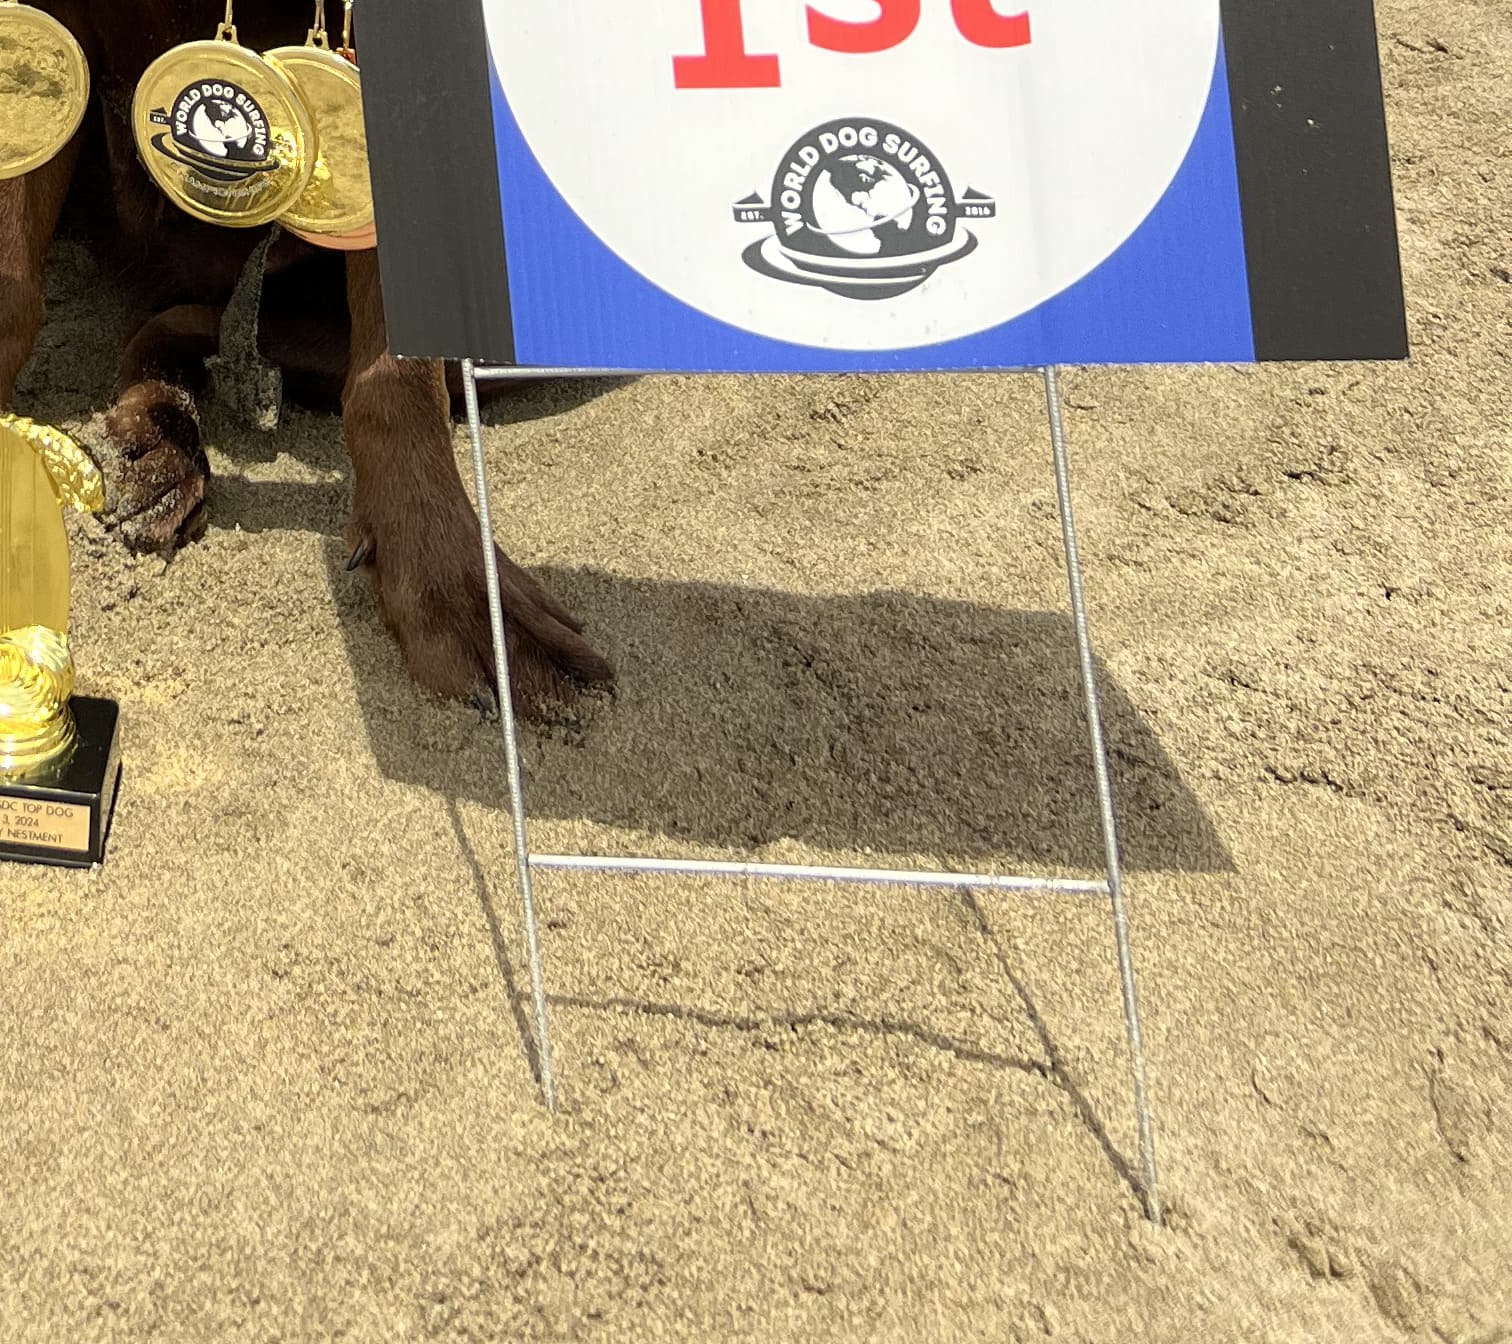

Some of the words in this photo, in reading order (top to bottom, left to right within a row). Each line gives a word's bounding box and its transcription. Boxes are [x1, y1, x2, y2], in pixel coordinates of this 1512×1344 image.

[175, 88, 201, 136] WORLD
[201, 83, 235, 99] DOG
[235, 93, 267, 156] SURFING
[780, 145, 820, 237] WORLD
[818, 125, 878, 154] DOG
[882, 133, 947, 236] SURFING
[22, 802, 42, 813] TOP
[45, 804, 74, 818] DOG
[14, 815, 40, 827] 2024
[7, 828, 64, 844] NESTMENT
